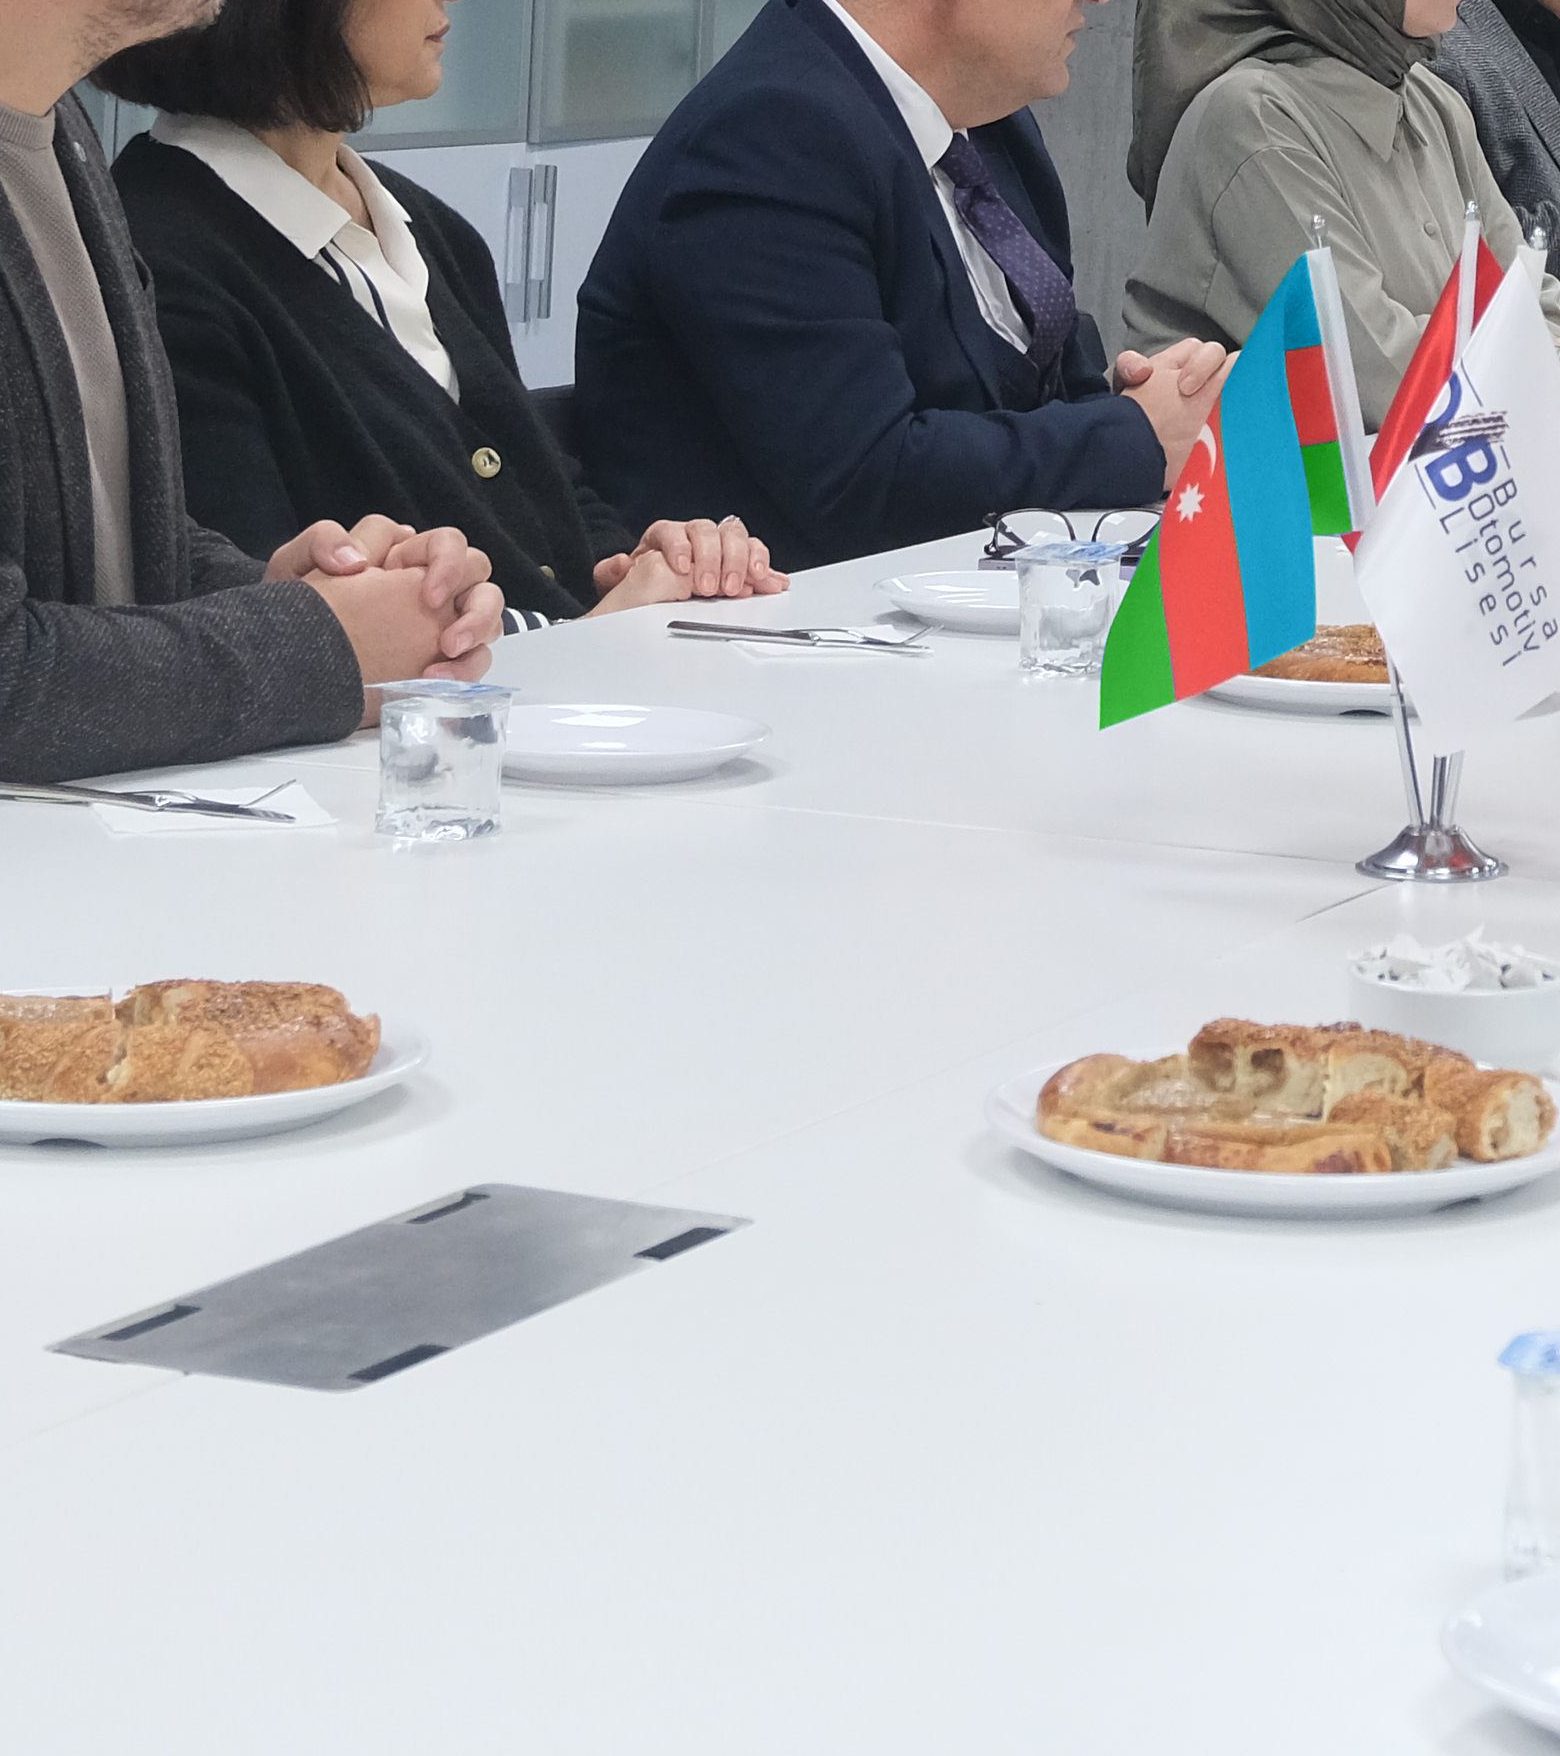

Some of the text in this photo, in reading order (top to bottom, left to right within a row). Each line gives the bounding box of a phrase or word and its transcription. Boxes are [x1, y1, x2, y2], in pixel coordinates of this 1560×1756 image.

[1439, 506, 1522, 667] Lisesi
[1467, 493, 1540, 653] Otomotiv
[1492, 478, 1559, 641] Bursa
